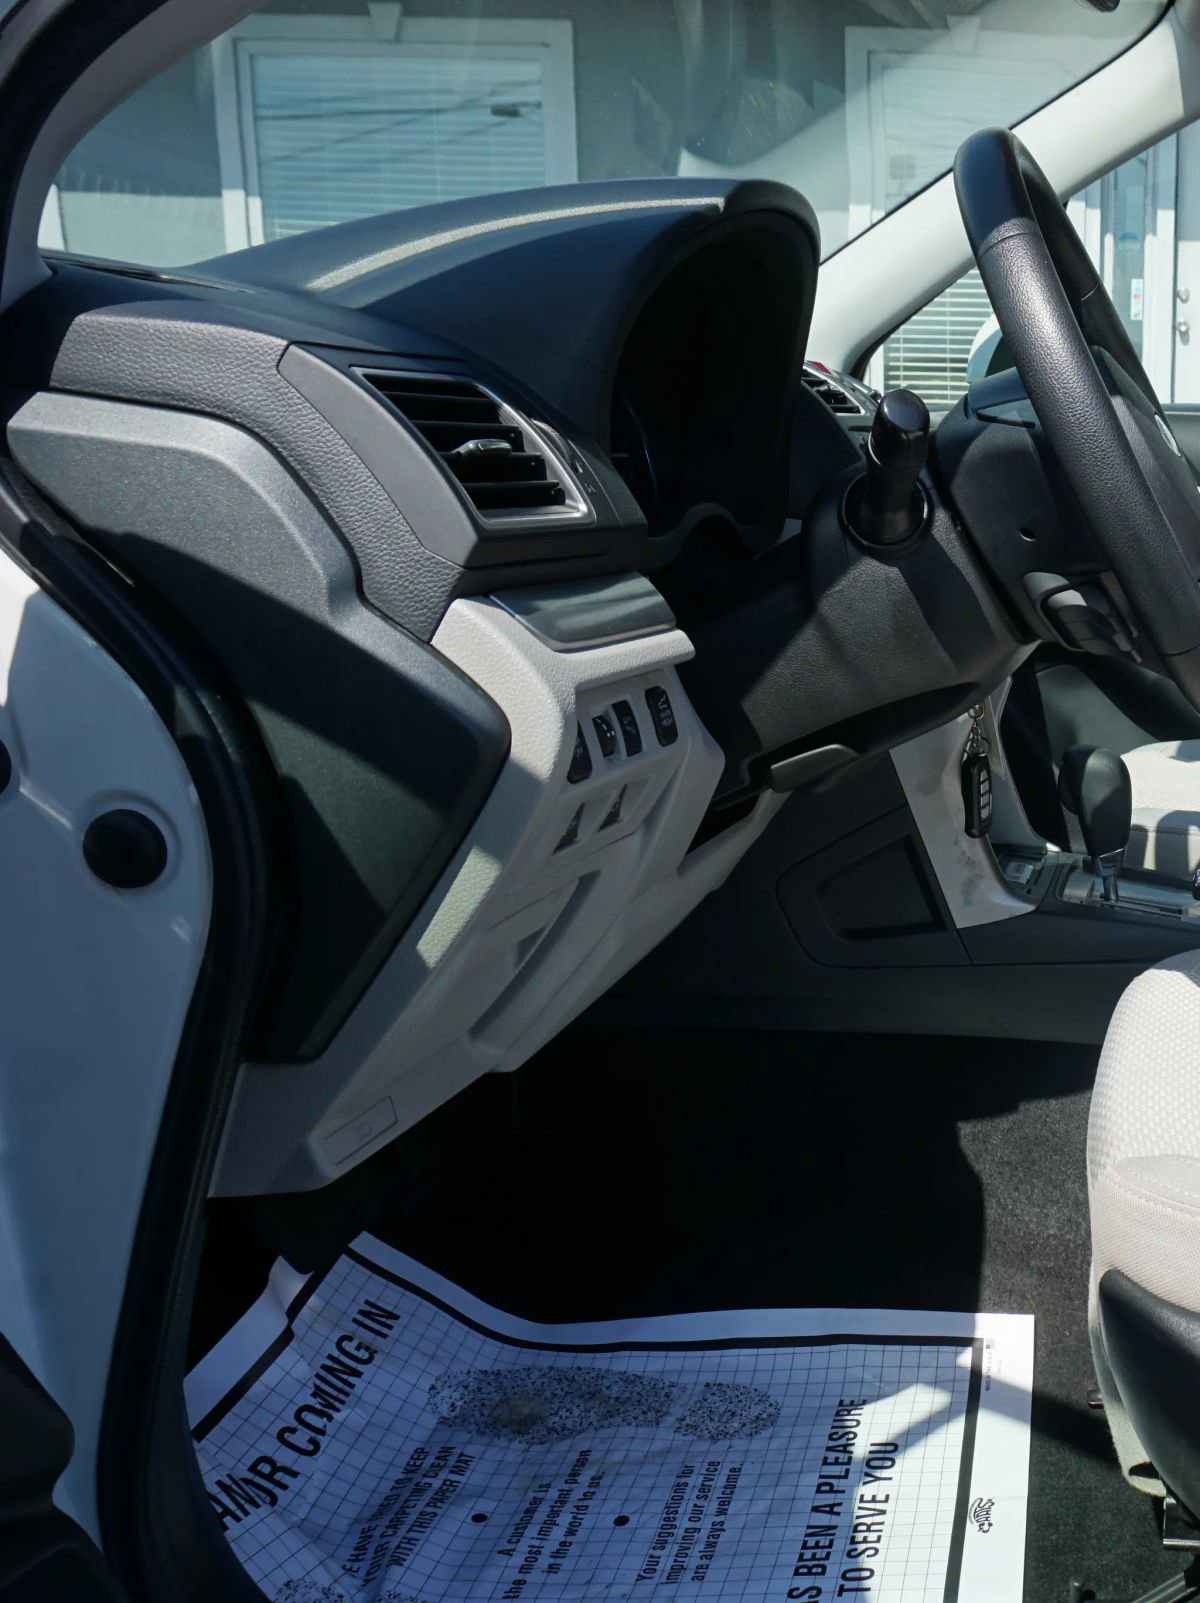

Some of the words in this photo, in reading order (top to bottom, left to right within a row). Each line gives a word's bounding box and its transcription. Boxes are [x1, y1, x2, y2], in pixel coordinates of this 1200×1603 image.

[276, 1334, 379, 1457] COMING
[352, 1299, 400, 1339] IN
[401, 1447, 429, 1475] KEEP
[816, 1399, 867, 1494] PLEASURE
[863, 1442, 899, 1486] YOU
[390, 1477, 413, 1491] TO
[564, 1449, 592, 1485] person
[696, 1461, 721, 1500] service
[577, 1491, 596, 1502] to
[714, 1463, 743, 1517] welcome.
[811, 1502, 843, 1516] A
[360, 1540, 392, 1587] YOUR
[380, 1481, 432, 1538] CARPETING
[422, 1446, 456, 1479] CLEAN
[385, 1536, 420, 1568] WITH
[406, 1510, 438, 1534] THIS
[425, 1479, 461, 1509] PAPER
[449, 1451, 475, 1476] MAT
[497, 1547, 516, 1557] A
[507, 1496, 545, 1544] customer
[533, 1483, 551, 1493] is
[530, 1488, 573, 1541] important
[563, 1504, 590, 1537] world
[636, 1554, 661, 1582] Your
[652, 1482, 689, 1550] suggestions
[676, 1464, 695, 1479] for
[688, 1503, 705, 1522] our
[846, 1494, 890, 1558] SERVE
[346, 1524, 378, 1562] HAVE
[517, 1544, 544, 1574] most
[549, 1541, 573, 1559] the
[698, 1520, 726, 1560] always
[793, 1524, 838, 1577] BEEN
[541, 1563, 562, 1574] in
[691, 1564, 709, 1581] are
[837, 1567, 875, 1597] TO
[502, 1579, 527, 1600] the
